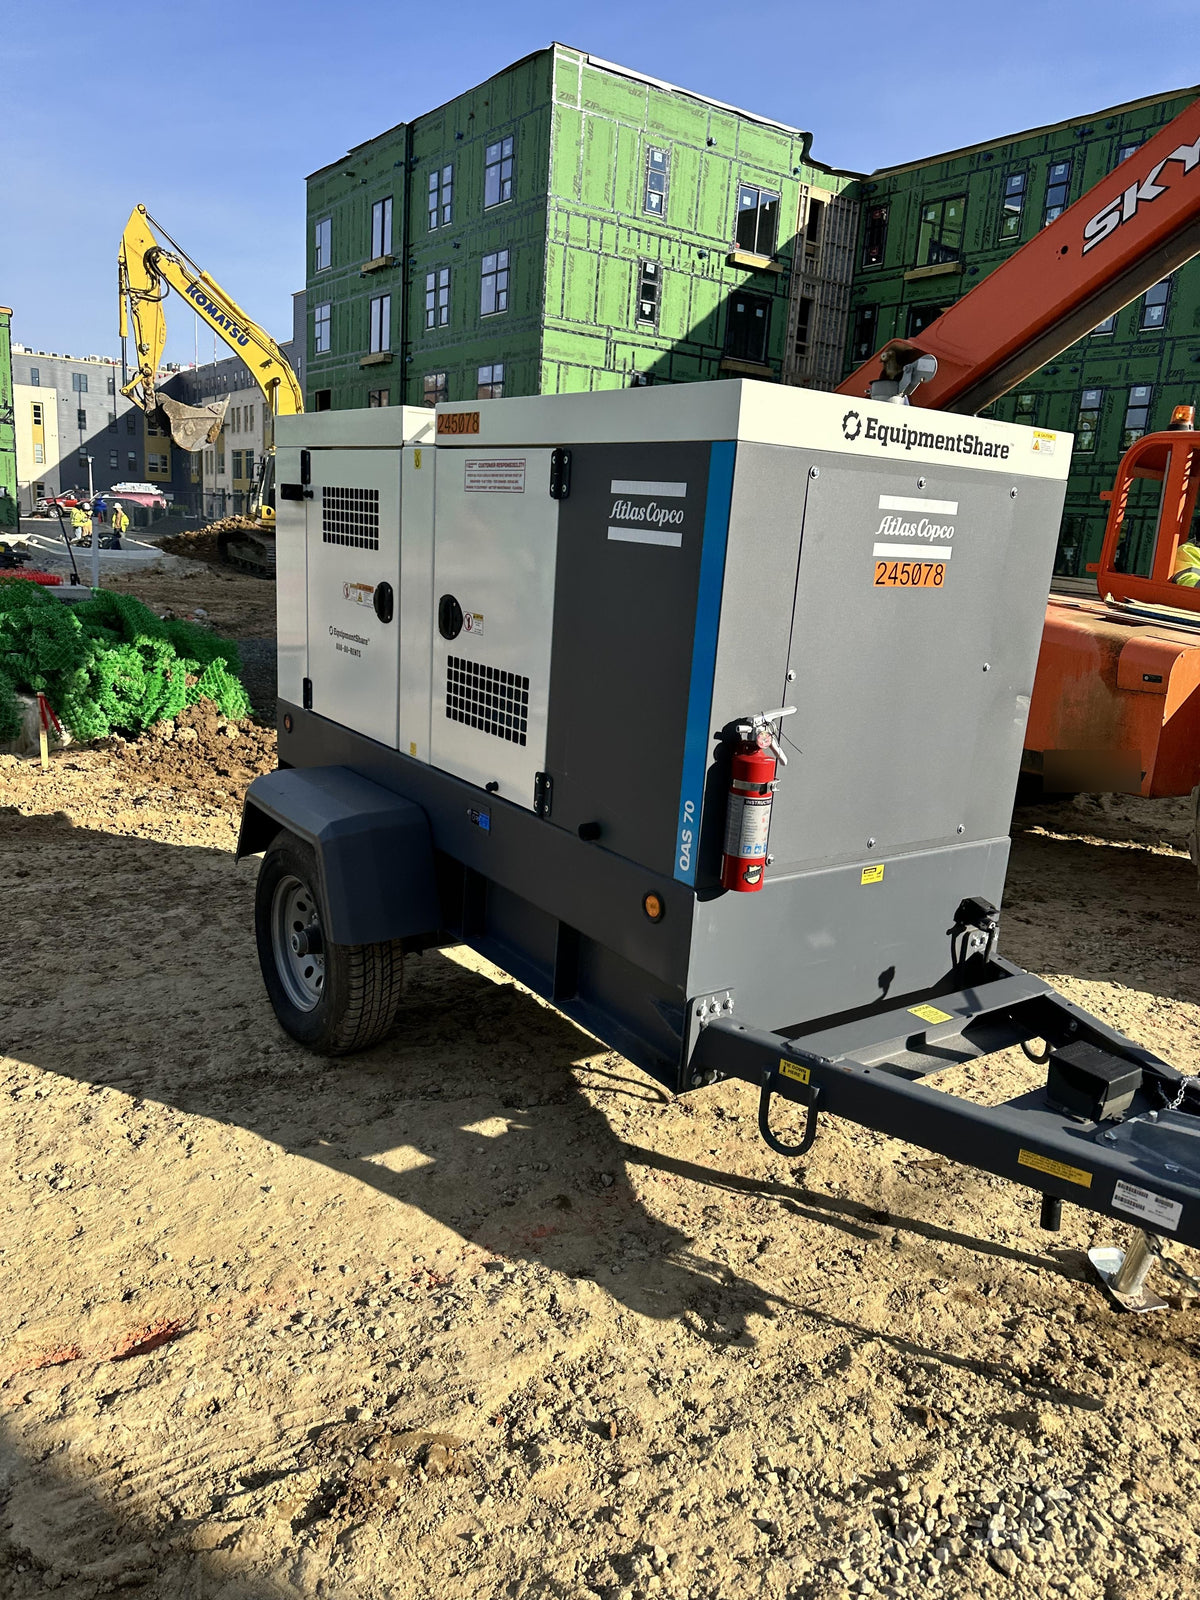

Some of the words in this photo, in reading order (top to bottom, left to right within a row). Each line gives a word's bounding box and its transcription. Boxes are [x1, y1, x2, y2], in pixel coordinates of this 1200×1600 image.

[559, 91, 575, 101] ZIP
[584, 100, 599, 109] ZIP
[621, 246, 636, 255] ZIP
[185, 284, 249, 346] KOMATSU
[437, 412, 479, 433] 245078
[864, 417, 1009, 459] EquipmentShare
[875, 562, 944, 586] 245078
[334, 627, 368, 646] EquipmentShare
[683, 800, 695, 823] 70
[679, 829, 693, 871] QAS
